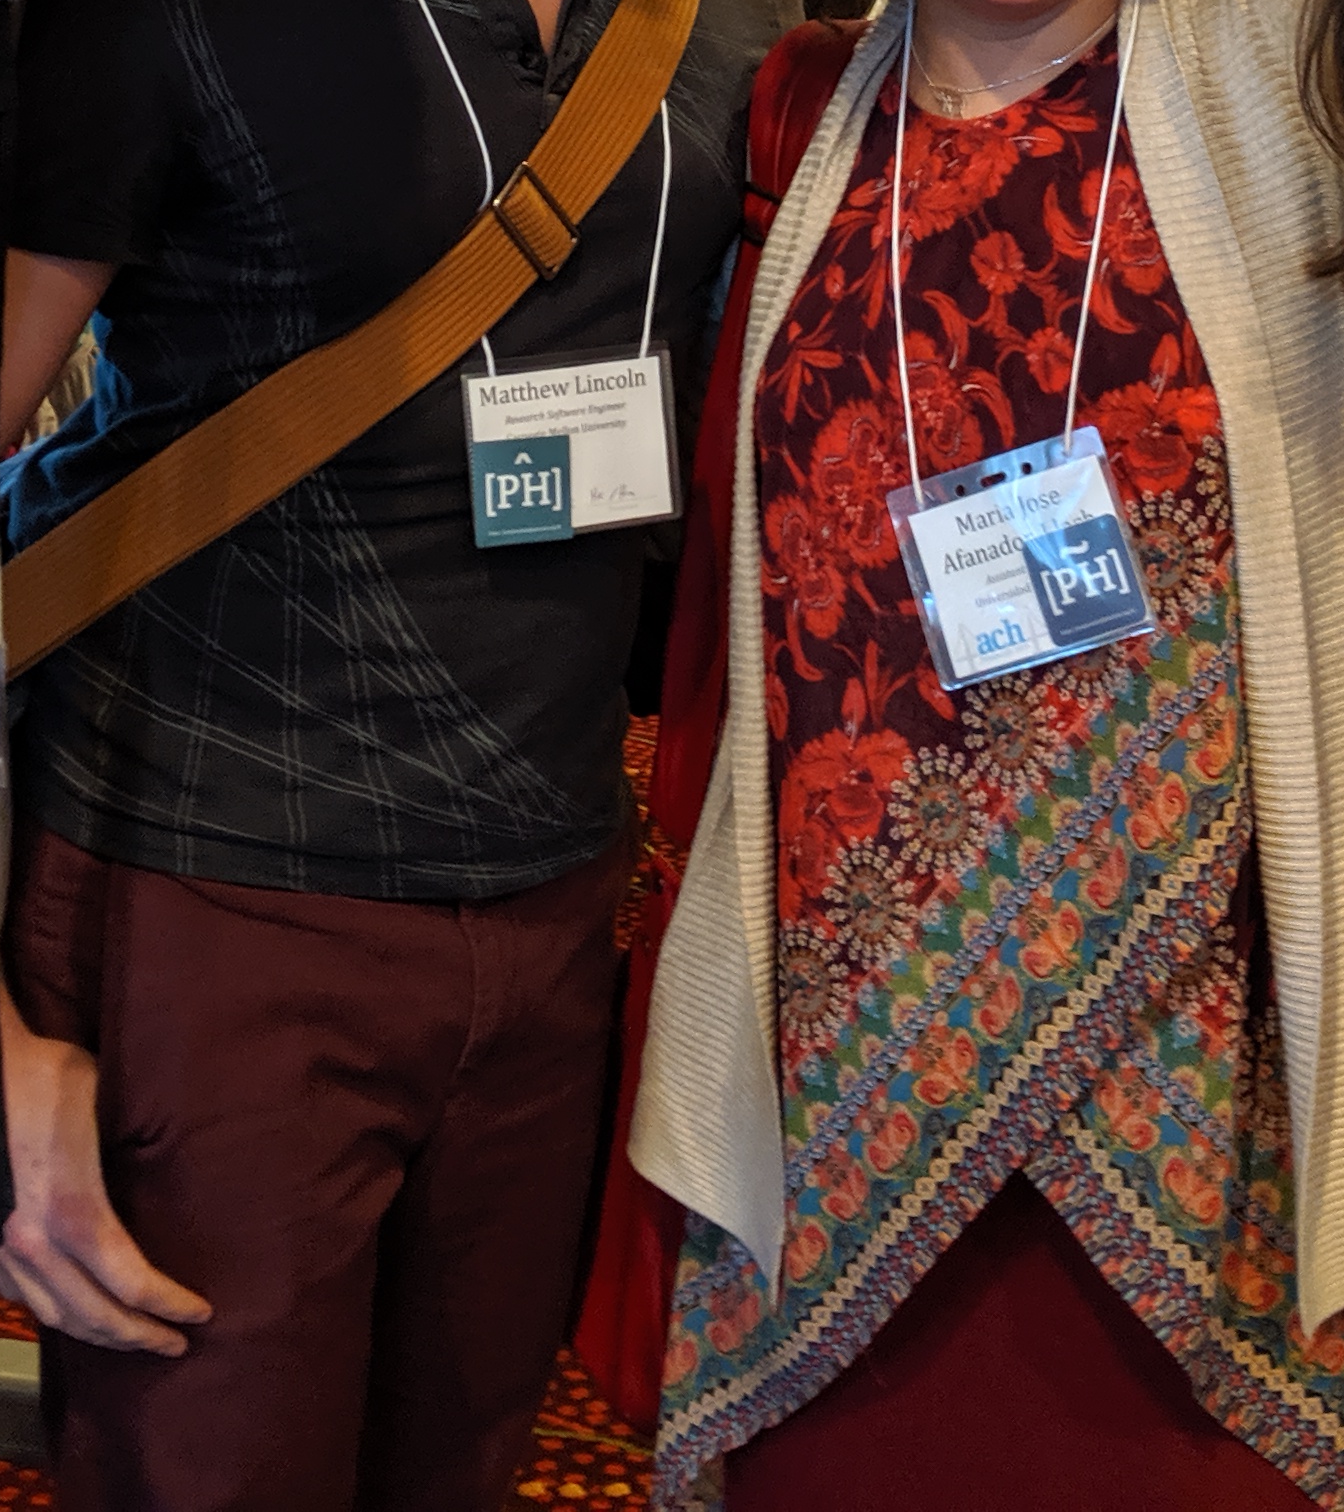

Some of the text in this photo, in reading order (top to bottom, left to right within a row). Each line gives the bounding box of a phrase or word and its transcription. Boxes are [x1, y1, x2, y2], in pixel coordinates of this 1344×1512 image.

[479, 368, 646, 407] Matthew Lincoln
[976, 618, 1026, 655] ach
